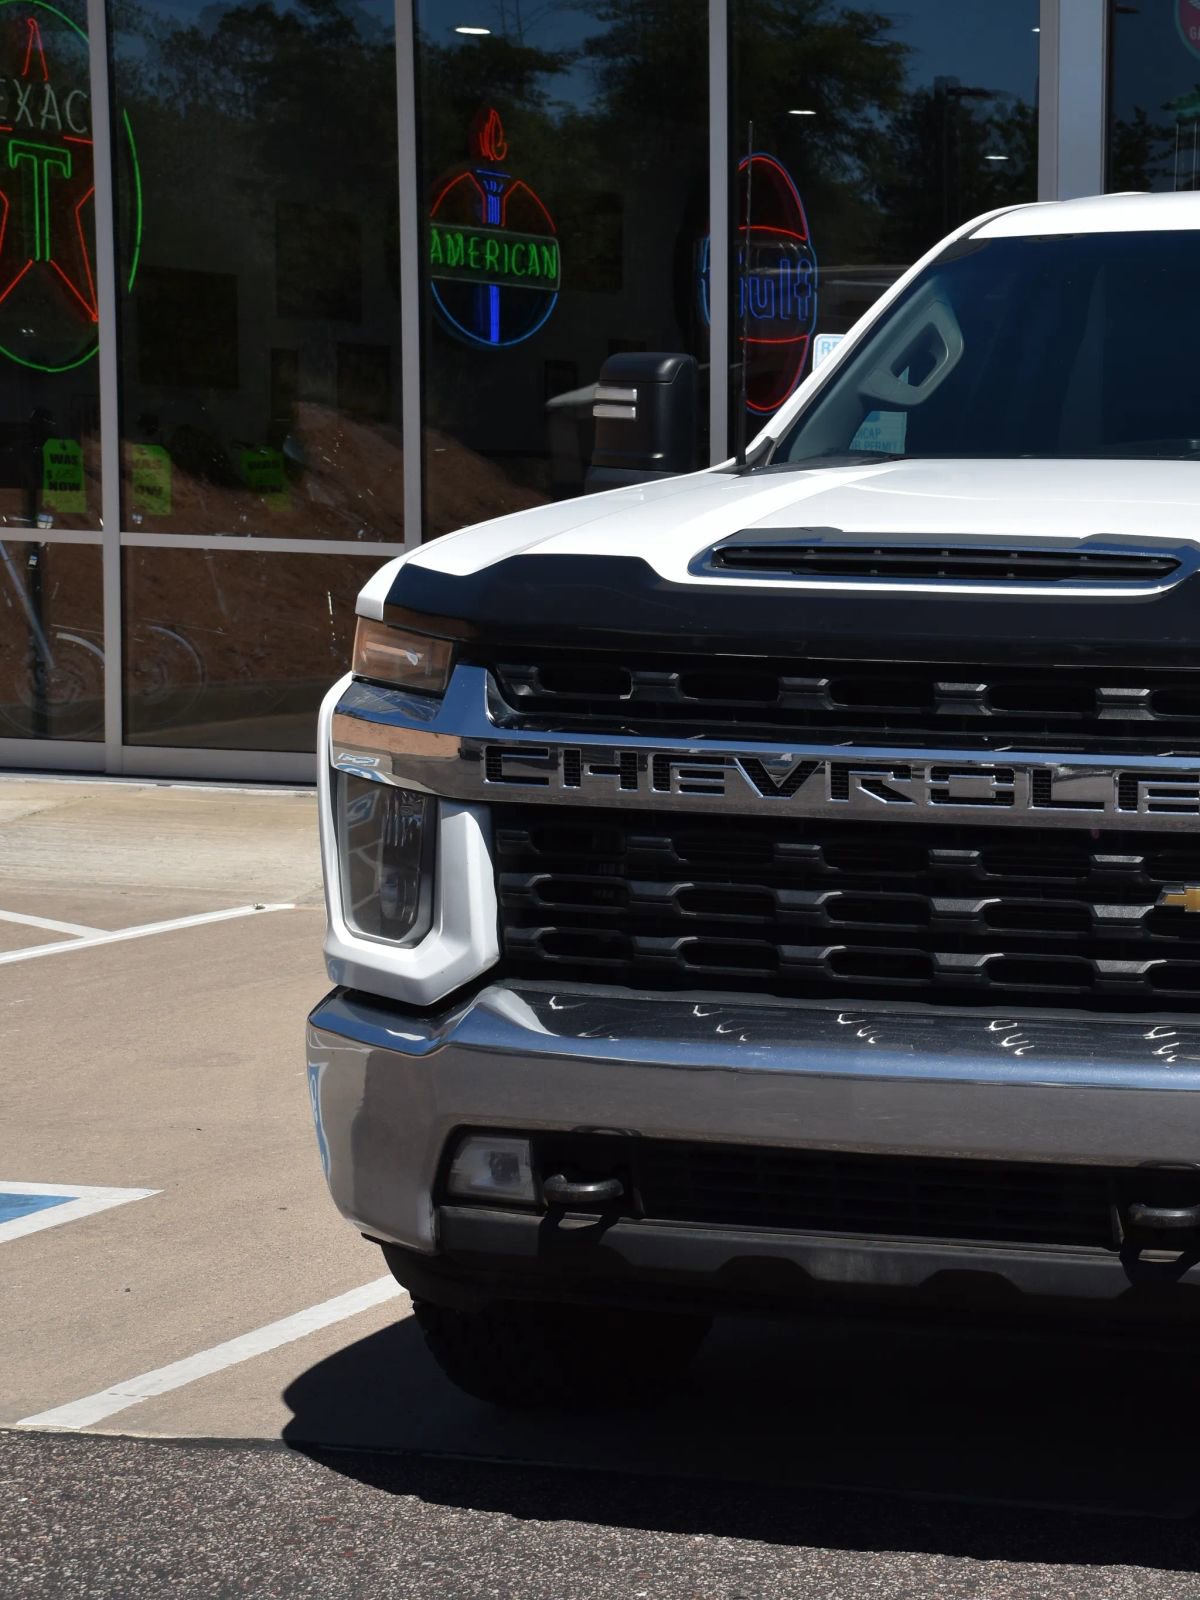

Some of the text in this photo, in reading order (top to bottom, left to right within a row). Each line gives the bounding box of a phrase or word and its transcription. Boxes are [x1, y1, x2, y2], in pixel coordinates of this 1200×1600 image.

[8, 139, 72, 262] T
[430, 228, 558, 280] AMERICAN
[49, 453, 79, 465] WAS
[48, 480, 81, 492] NOW
